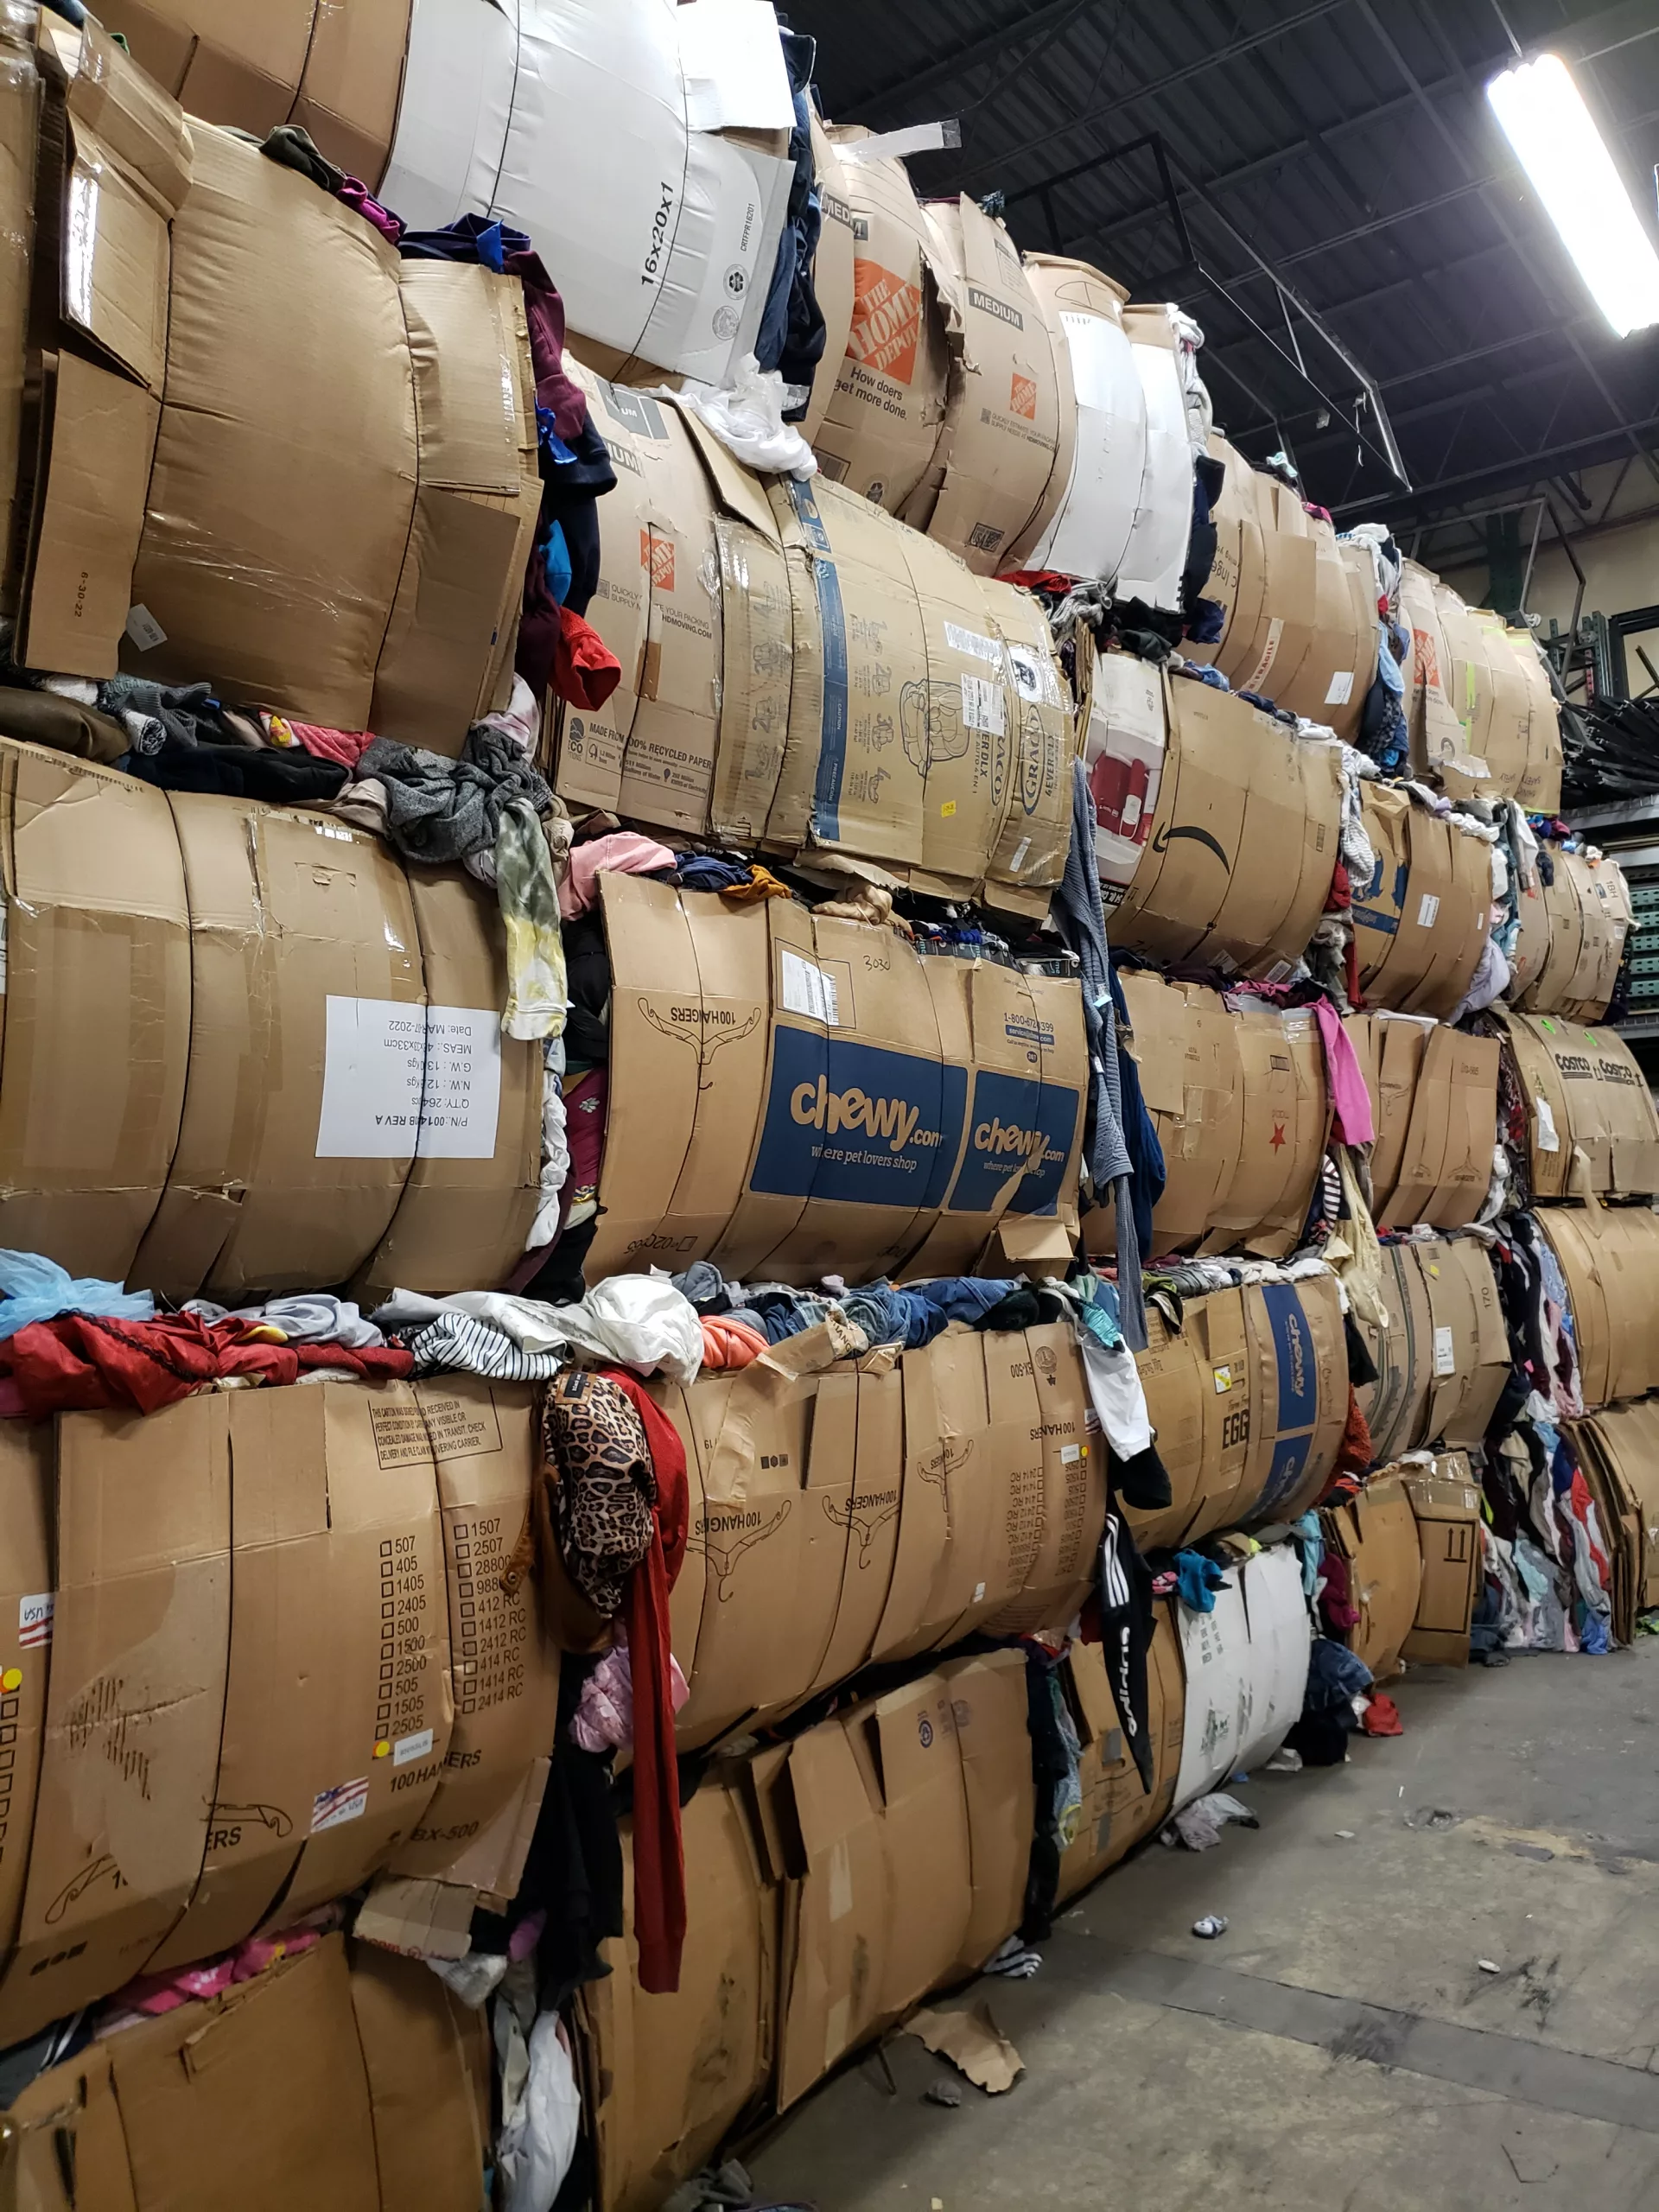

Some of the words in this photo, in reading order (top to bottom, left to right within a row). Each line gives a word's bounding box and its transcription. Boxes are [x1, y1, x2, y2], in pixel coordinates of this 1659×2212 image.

[640, 180, 674, 286] 16x20x1
[973, 292, 1020, 327] MEDIUM
[850, 366, 875, 386] How
[877, 380, 903, 401] doers
[834, 378, 855, 395] get
[855, 389, 882, 408] more
[883, 400, 907, 421] done.
[74, 571, 89, 618] 6-30-22
[611, 584, 639, 600] QUICKLY
[611, 593, 635, 608] SUPPLY
[661, 614, 712, 640] HDMOVING.COM
[665, 605, 683, 619] YOUR
[683, 613, 709, 630] PACKING
[1255, 640, 1274, 680] FRAGILE
[589, 722, 608, 737] MADE
[608, 729, 625, 743] FROM
[649, 743, 687, 762] RECYCLED
[689, 754, 712, 770] PAPER
[980, 752, 989, 778] DLX
[448, 1026, 471, 1037] Date:
[1554, 1052, 1591, 1071] COSTCO
[375, 1115, 384, 1125] A
[391, 1116, 406, 1125] REV
[843, 1150, 862, 1165] pet
[863, 1150, 893, 1167] lovers
[893, 1155, 918, 1173] shop
[1481, 1286, 1492, 1309] 170
[427, 1402, 453, 1414] RECEIVED
[454, 1401, 461, 1409] IN
[375, 1421, 391, 1433] PERFECT
[436, 1414, 457, 1427] VISIBLE
[458, 1412, 467, 1422] OR
[378, 1433, 402, 1446] CONCEALED
[444, 1426, 467, 1438] TRANSIT.
[467, 1421, 486, 1433] CHECK
[380, 1448, 400, 1461] DELIVERY
[457, 1436, 482, 1450] CARRIER.
[1010, 1471, 1021, 1483] RC
[1009, 1484, 1021, 1496] RC
[1012, 1497, 1023, 1508] RC
[1007, 1510, 1018, 1521] RC
[471, 1518, 501, 1536] 1507
[1006, 1522, 1018, 1533] RC
[395, 1535, 416, 1554] 507
[474, 1537, 503, 1556] 2507
[1007, 1534, 1019, 1544] RC
[396, 1555, 418, 1574] 405
[397, 1574, 424, 1594] 1405
[397, 1595, 427, 1616] 2405
[478, 1595, 500, 1614] 412
[503, 1592, 520, 1607] RC
[397, 1617, 419, 1636] 500
[479, 1613, 506, 1633] 1412
[509, 1609, 526, 1625] RC
[397, 1635, 426, 1656] 1500
[480, 1633, 508, 1653] 2412
[510, 1626, 527, 1643] RC
[397, 1656, 427, 1676] 2500
[480, 1652, 501, 1669] 414
[504, 1647, 520, 1664] RC
[395, 1677, 419, 1696] 505
[480, 1672, 505, 1692] 1414
[507, 1665, 524, 1682] RC
[394, 1696, 424, 1716] 1505
[478, 1691, 505, 1711] 2414
[507, 1683, 524, 1700] RC
[391, 1715, 423, 1736] 2505
